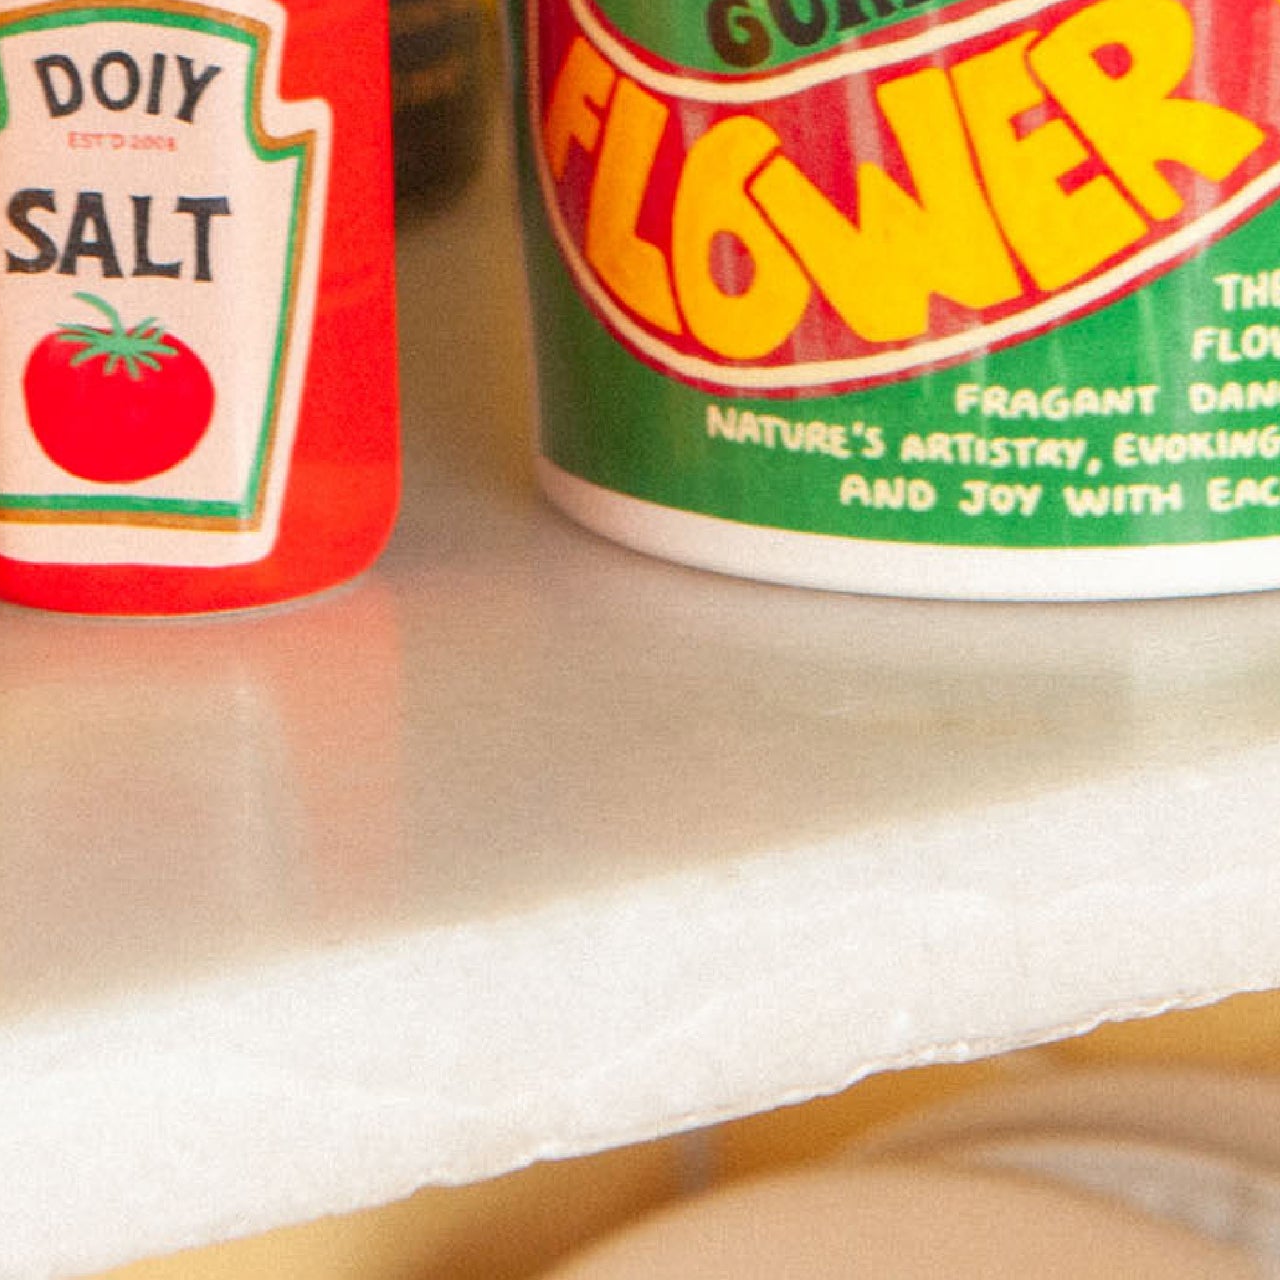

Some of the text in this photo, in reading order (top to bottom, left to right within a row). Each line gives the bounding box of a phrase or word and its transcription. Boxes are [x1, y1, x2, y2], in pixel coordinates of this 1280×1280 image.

[34, 50, 222, 124] DOIY
[5, 187, 232, 282] SALT
[953, 383, 1160, 420] FRAGANT
[705, 404, 886, 460] NATURE'S
[899, 432, 1104, 476] ARTISTRY,
[839, 473, 938, 512] AND
[958, 479, 1043, 517] JOY
[1062, 480, 1182, 518] WITH
